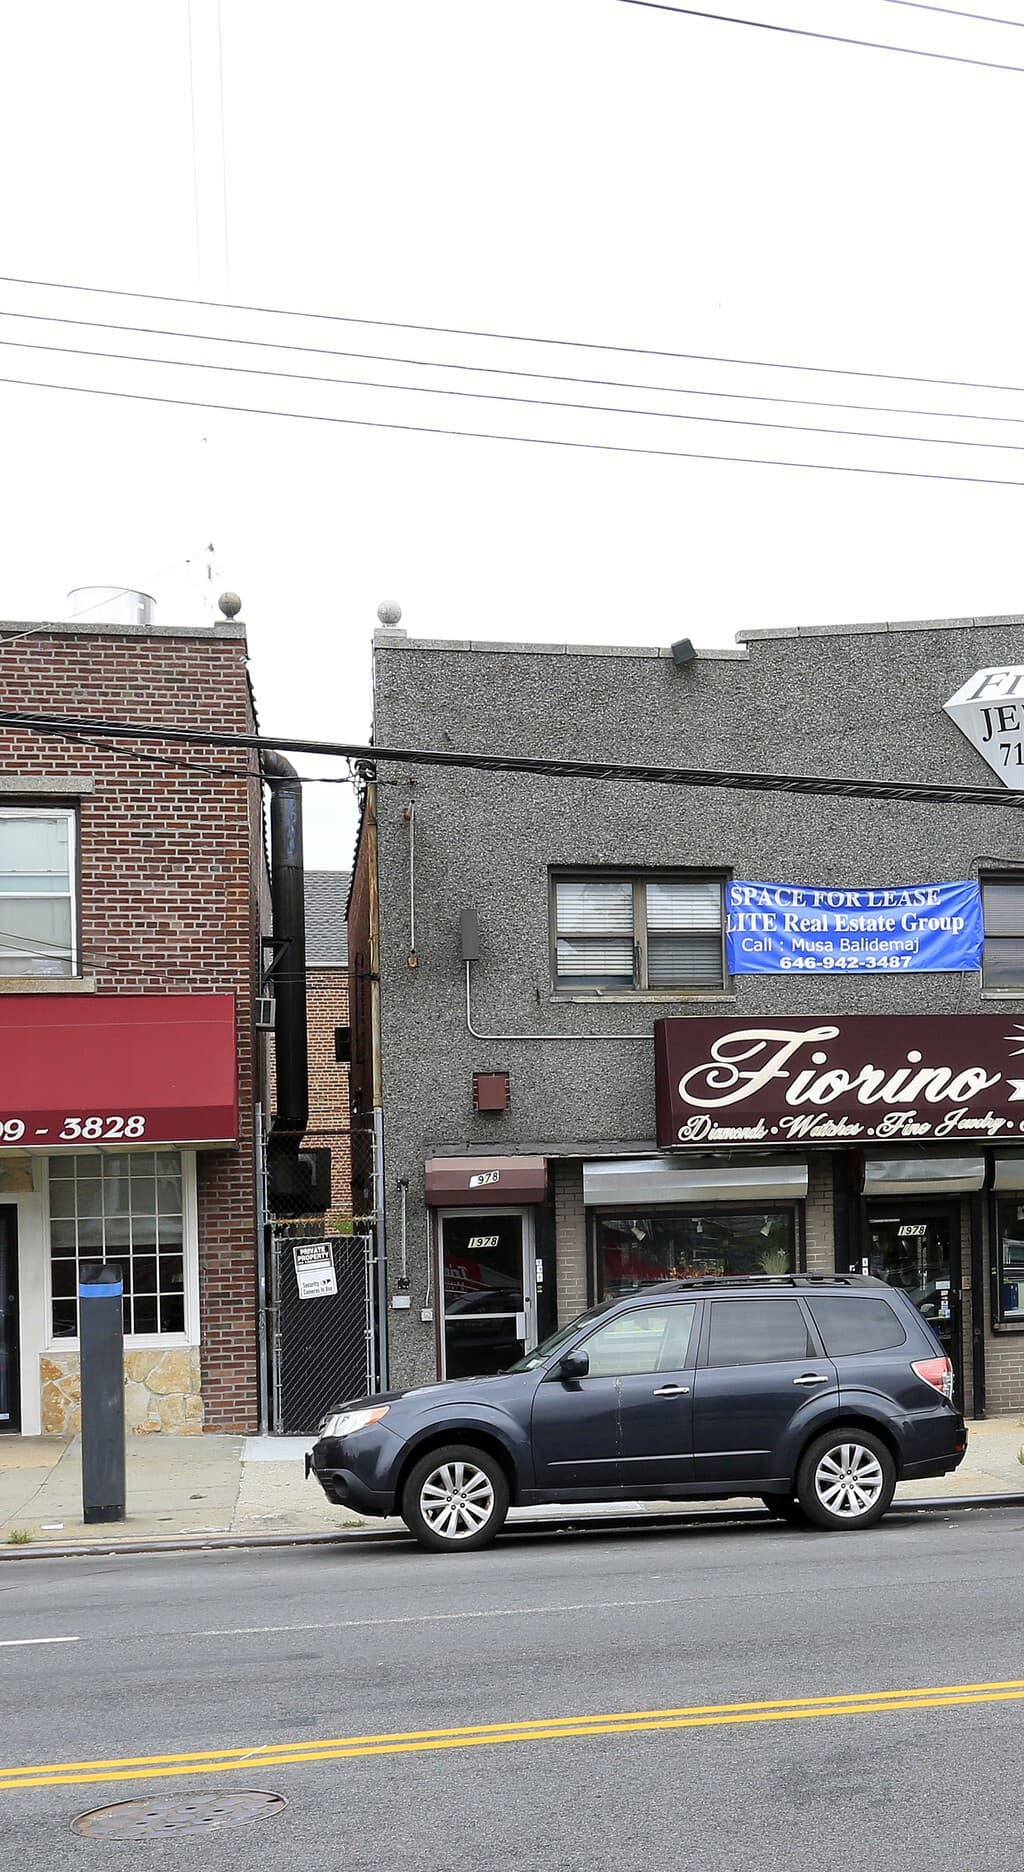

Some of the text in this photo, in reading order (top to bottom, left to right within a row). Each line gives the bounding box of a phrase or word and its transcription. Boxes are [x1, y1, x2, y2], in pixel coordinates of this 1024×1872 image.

[730, 886, 942, 908] SPACE FOR LEASE
[783, 913, 829, 933] Real
[834, 913, 895, 933] Estate
[901, 912, 965, 935] Group
[741, 937, 773, 952] Call
[791, 937, 834, 952] Musa
[839, 937, 920, 953] Balidemaj
[779, 955, 913, 970] 646-942-3487
[678, 1025, 1002, 1108] Fiorino
[59, 1115, 146, 1140] 3828
[678, 1114, 769, 1141] Diamonds
[779, 1112, 865, 1139] Watches
[876, 1110, 932, 1138] Fine
[900, 1224, 925, 1235] 1978
[470, 1237, 498, 1247] 1978
